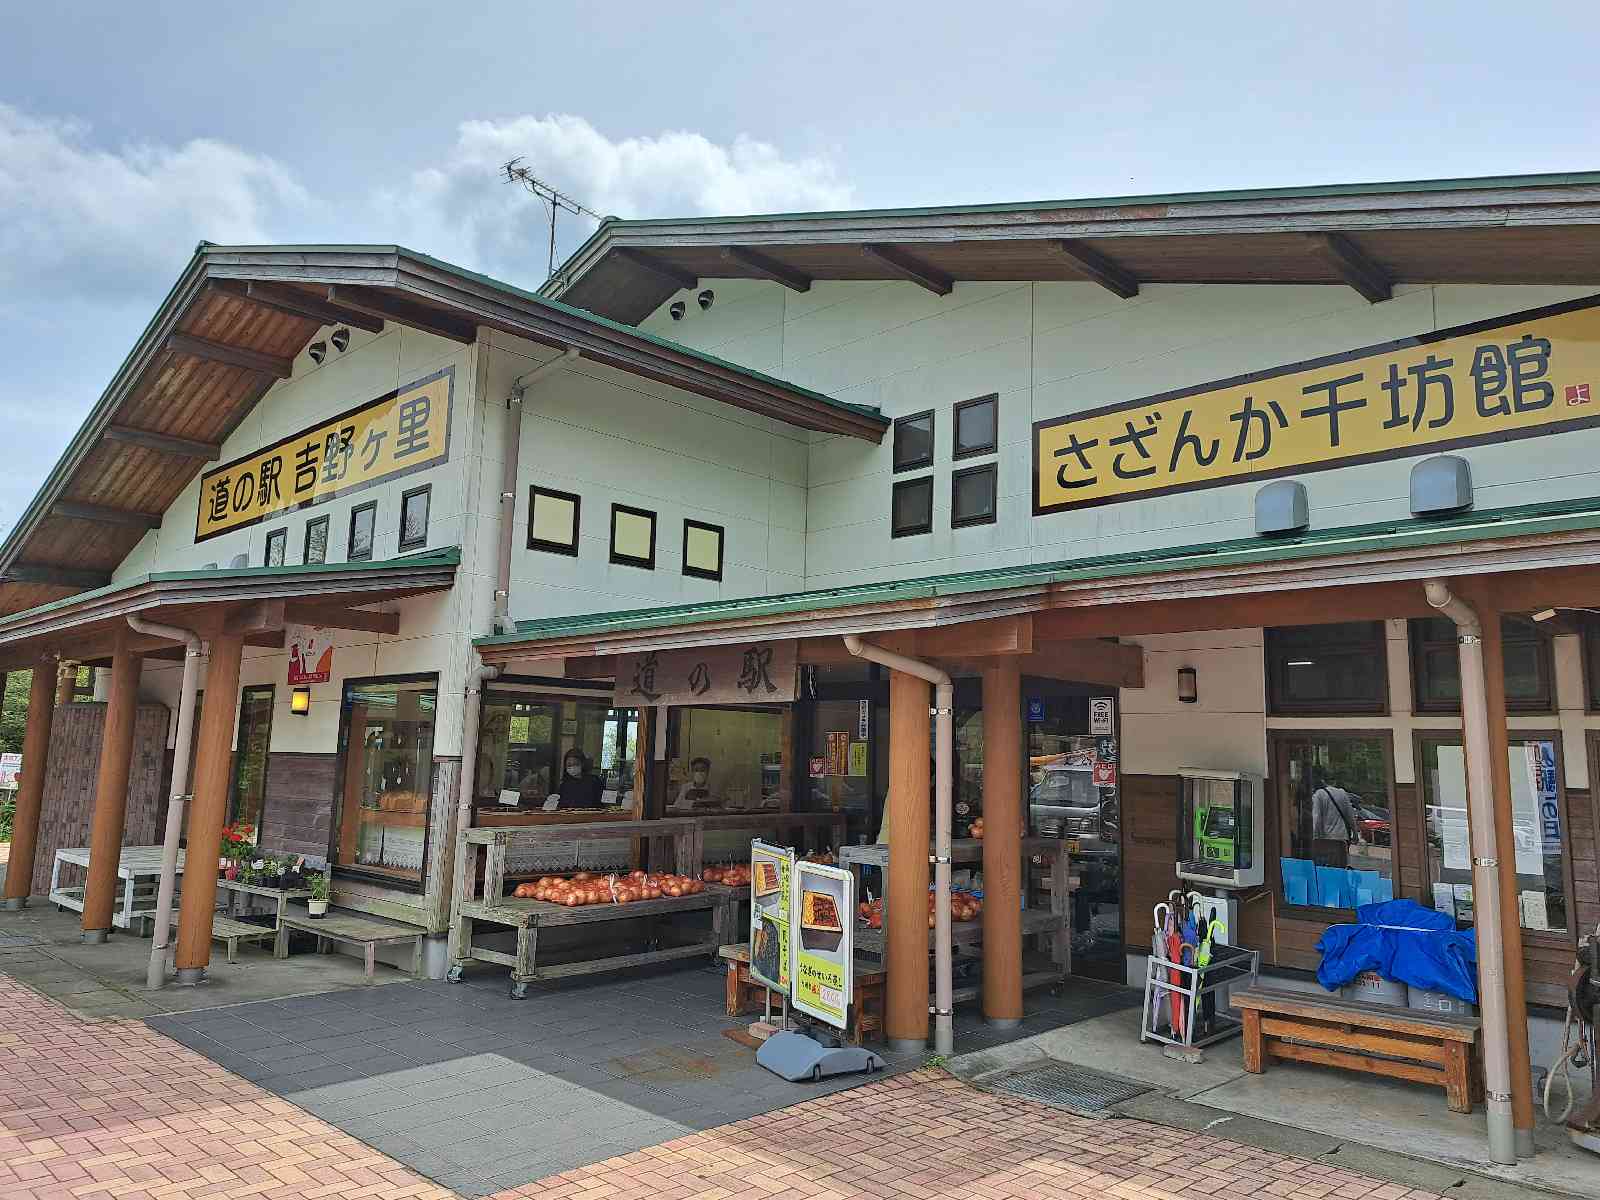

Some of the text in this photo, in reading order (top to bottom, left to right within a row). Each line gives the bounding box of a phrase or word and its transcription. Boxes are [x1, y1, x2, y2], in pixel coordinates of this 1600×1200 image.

[1053, 333, 1555, 490] さざんか千坊館
[630, 646, 778, 703] 道の駅
